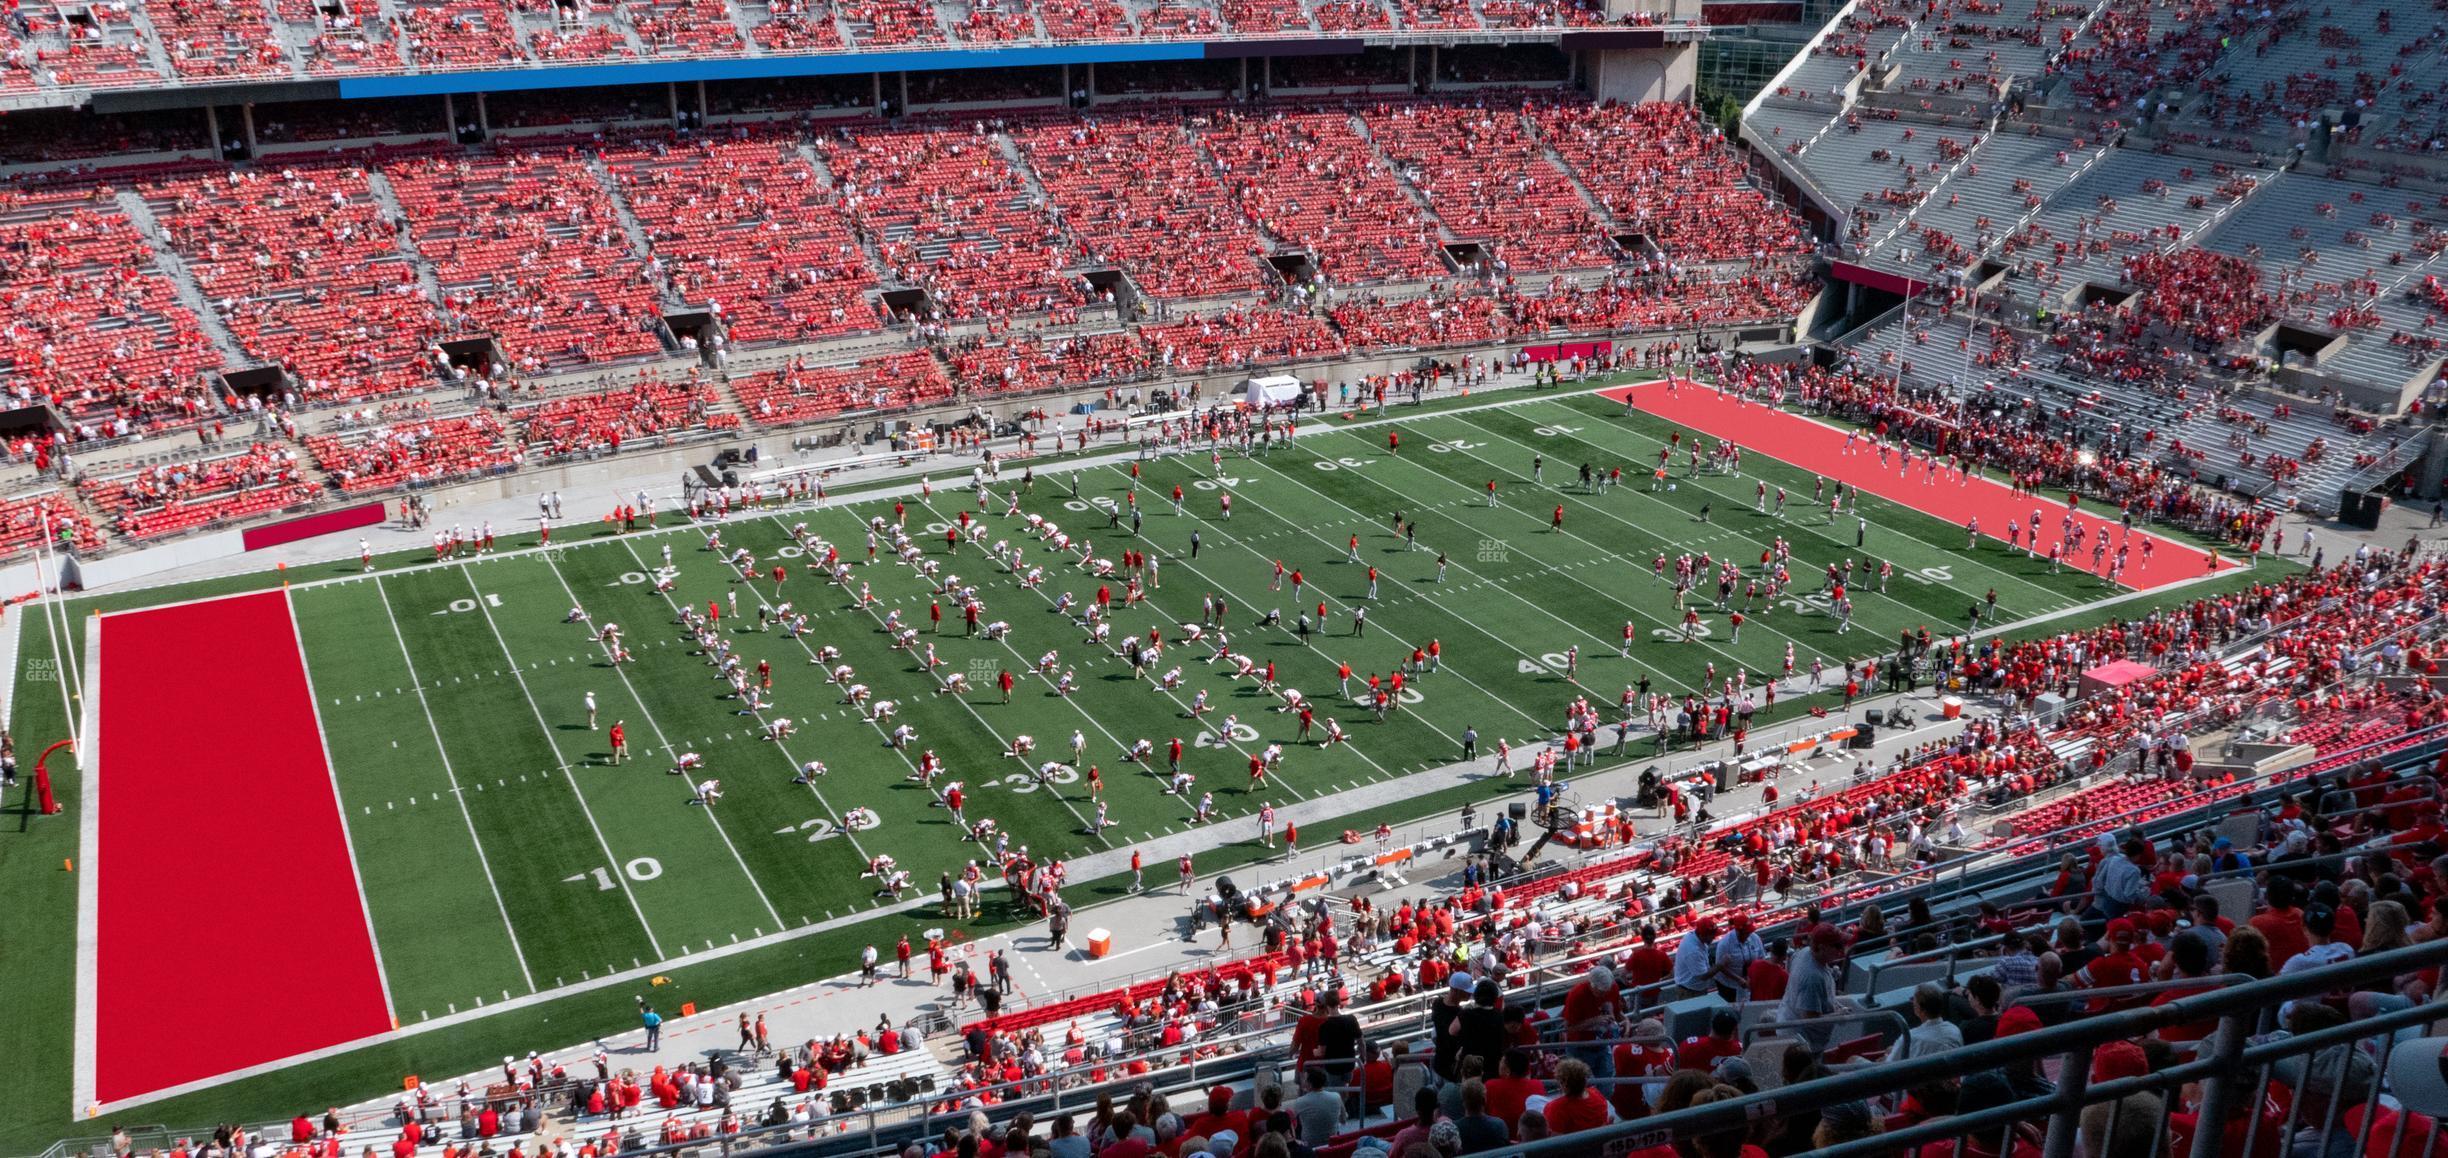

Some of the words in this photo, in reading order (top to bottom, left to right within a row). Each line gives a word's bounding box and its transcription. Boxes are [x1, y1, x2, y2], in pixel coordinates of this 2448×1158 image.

[1427, 440, 1474, 452] 20
[1314, 457, 1362, 470] 30
[1193, 477, 1239, 490] 40
[1064, 496, 1119, 511] 50
[1903, 568, 1953, 585] 10
[449, 594, 503, 612] 10
[1779, 594, 1834, 614] 20
[1651, 622, 1712, 642] 30
[1518, 653, 1569, 674] 40
[1194, 723, 1260, 749] 40
[1005, 764, 1079, 793] 30
[800, 808, 881, 842] 20
[591, 857, 662, 891] 10
